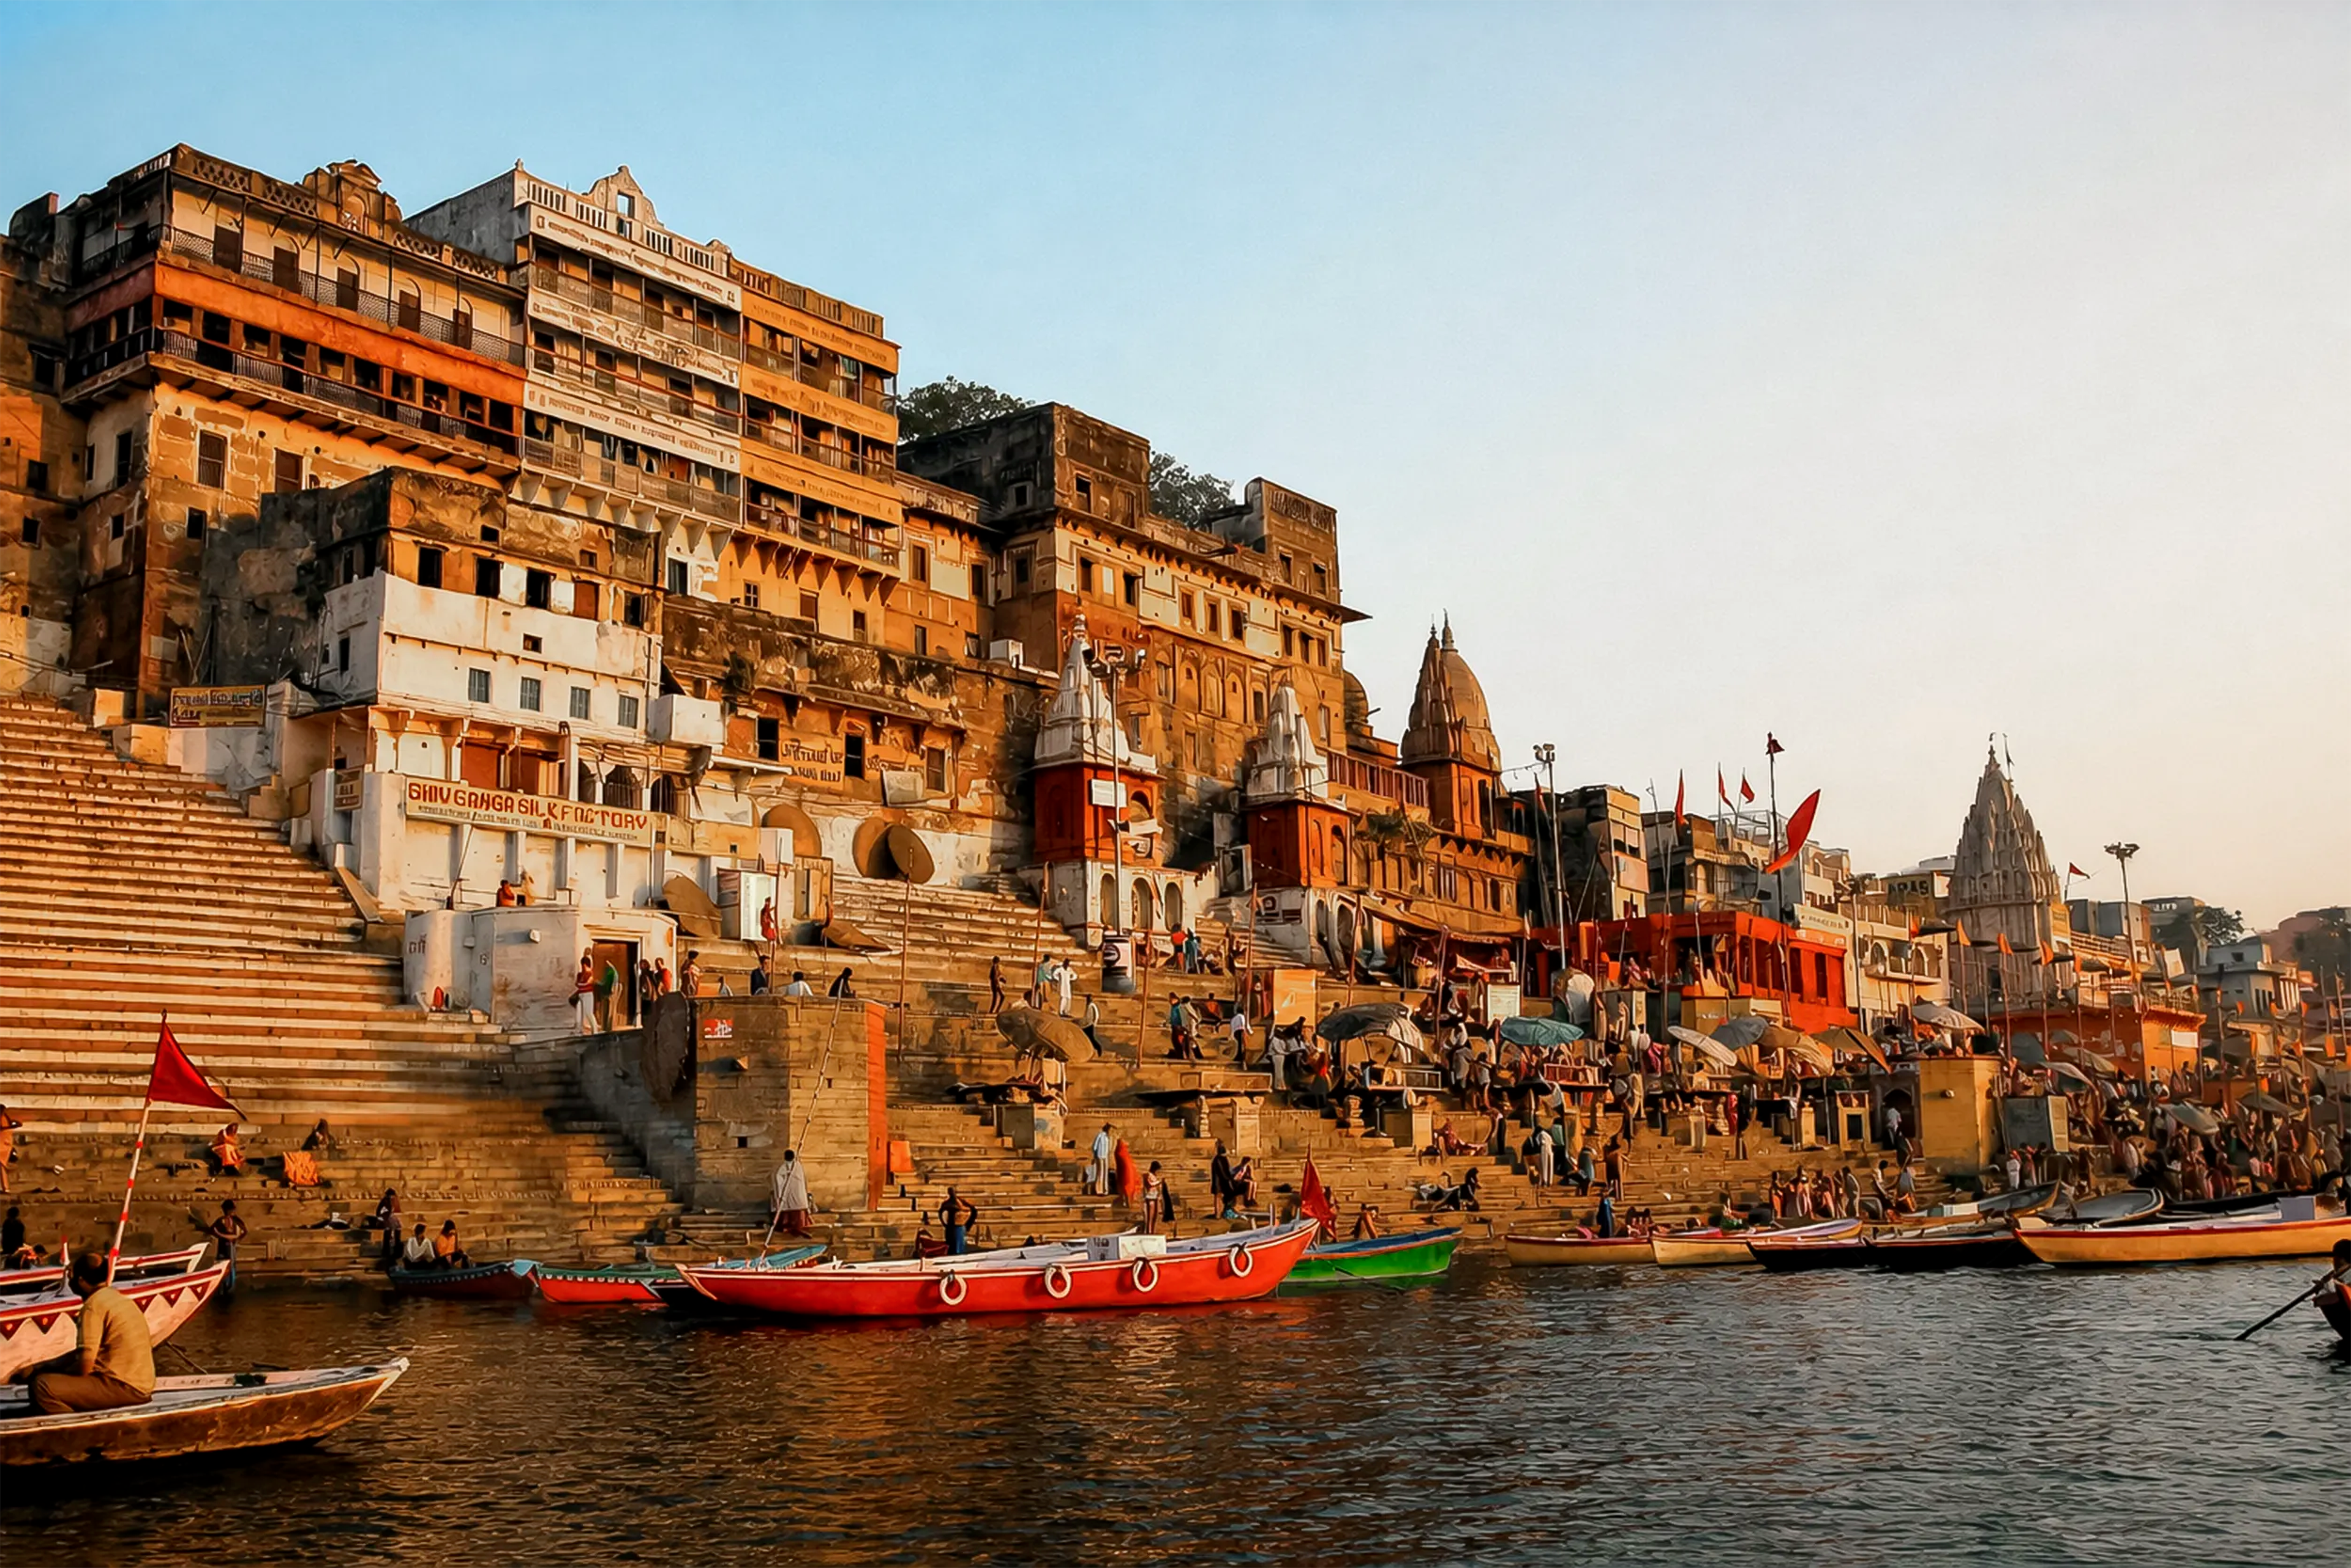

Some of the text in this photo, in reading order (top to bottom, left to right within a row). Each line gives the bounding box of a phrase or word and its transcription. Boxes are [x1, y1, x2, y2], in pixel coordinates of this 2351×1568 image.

[453, 789, 514, 814] GANGA
[517, 798, 558, 820] SILK
[561, 805, 647, 831] FACTORY
